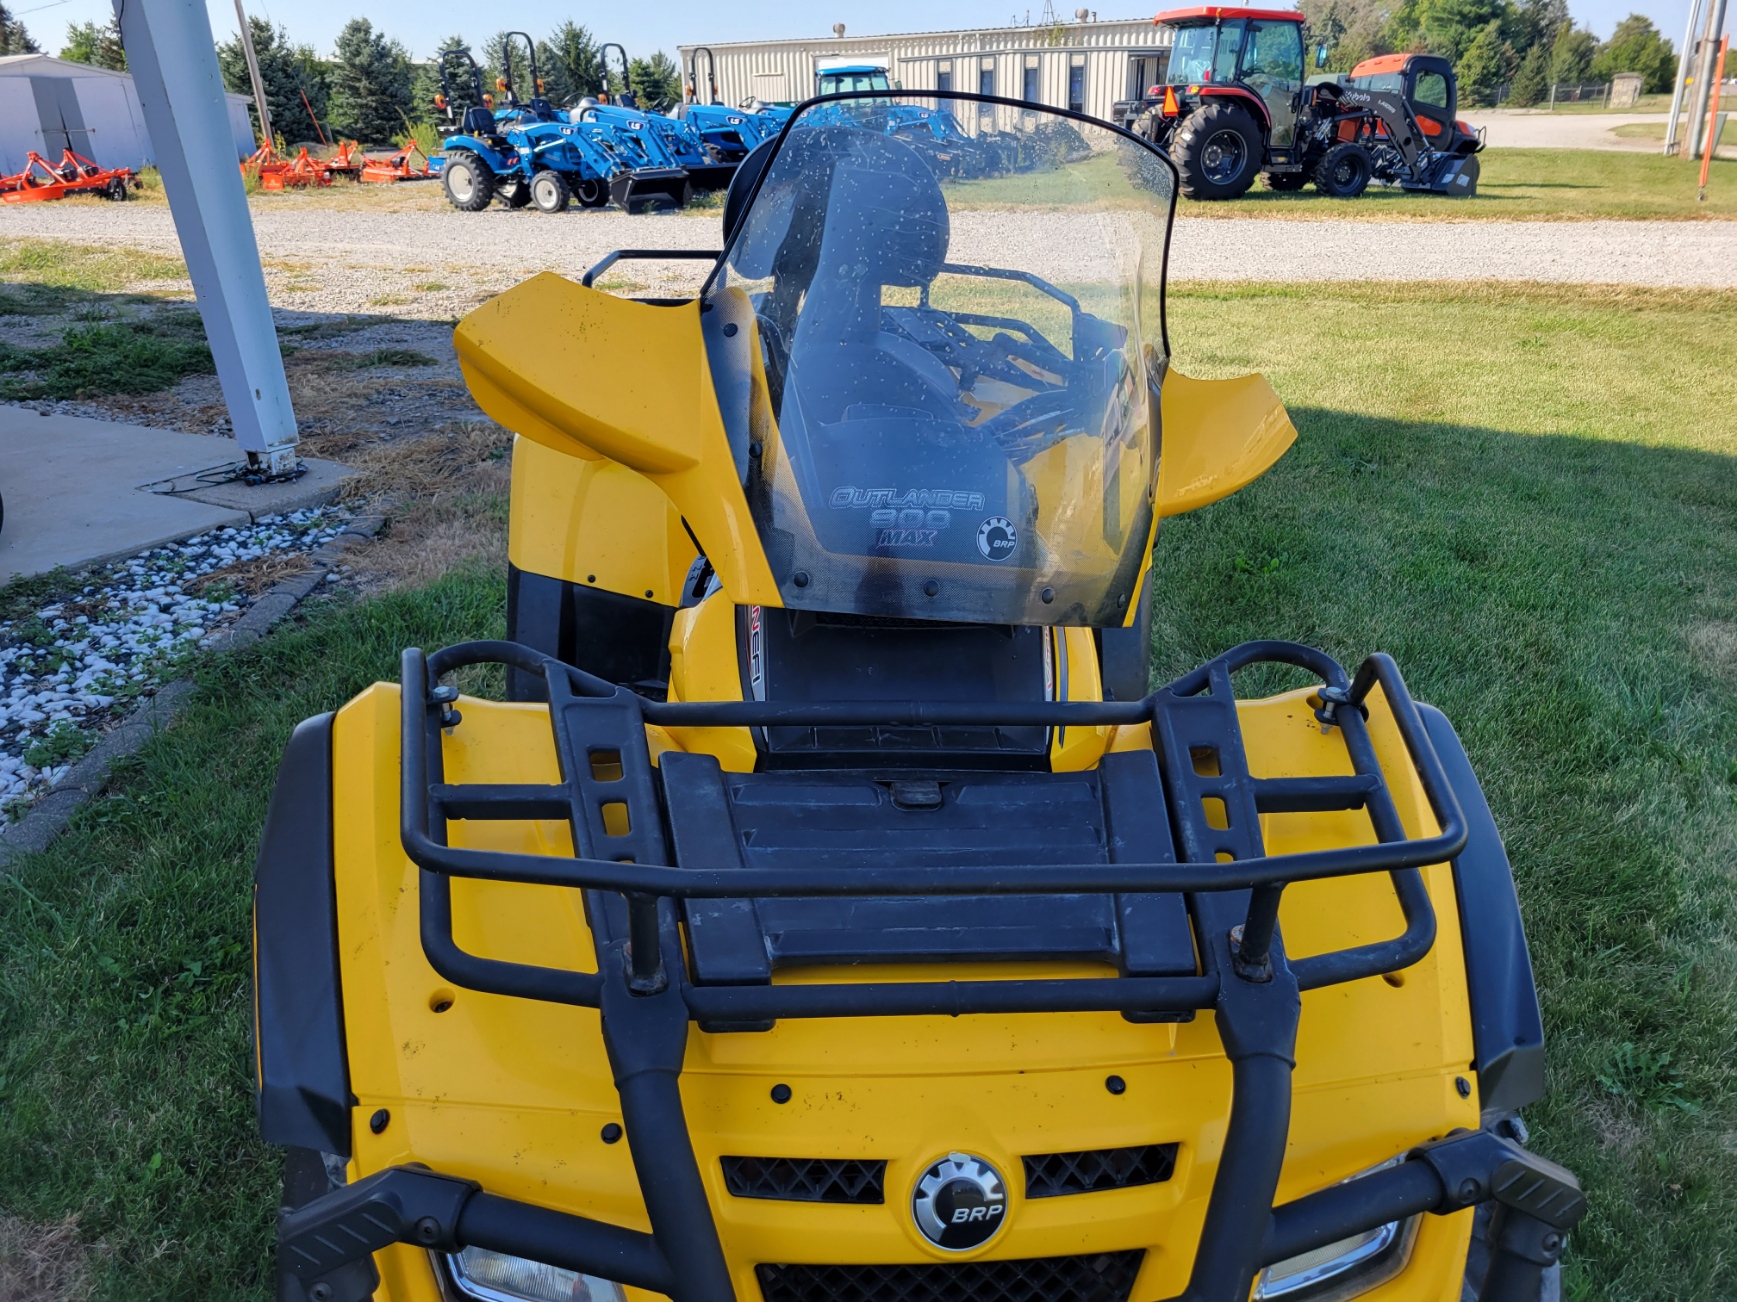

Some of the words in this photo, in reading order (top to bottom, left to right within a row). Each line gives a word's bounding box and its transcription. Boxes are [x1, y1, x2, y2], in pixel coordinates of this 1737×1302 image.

[829, 486, 986, 511] OUTLANDER
[877, 529, 938, 548] MAX
[993, 539, 1015, 548] BRP
[951, 1204, 1003, 1223] BRP
